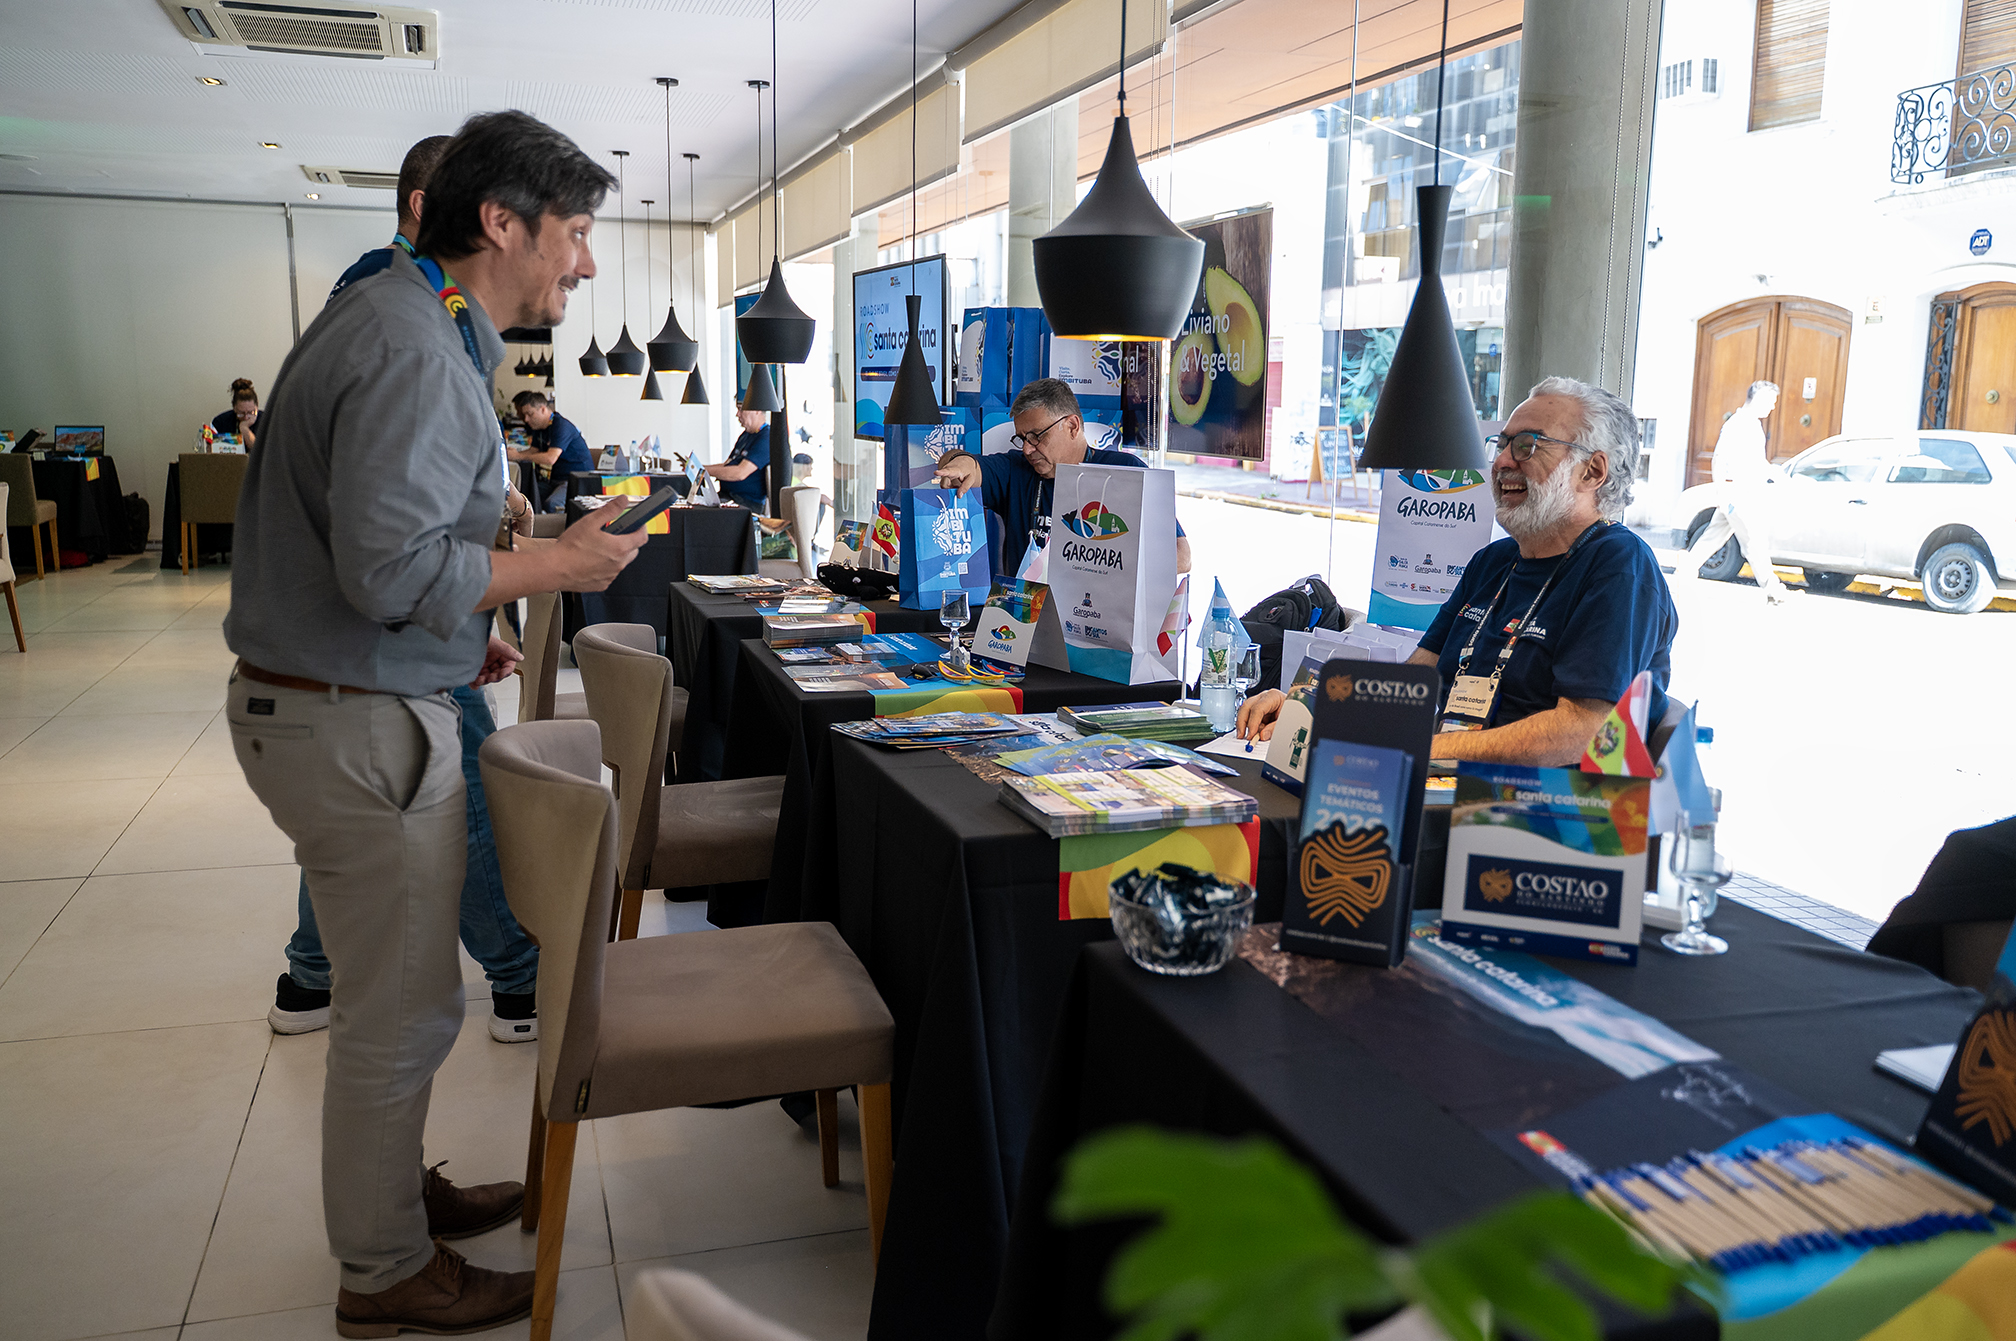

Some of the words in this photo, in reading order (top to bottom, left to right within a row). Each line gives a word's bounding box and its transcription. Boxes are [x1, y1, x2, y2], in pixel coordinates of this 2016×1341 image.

[1973, 236, 1989, 247] ADT
[860, 303, 889, 317] ROADSHOW
[1181, 307, 1230, 336] Liviano
[873, 327, 897, 351] santa
[898, 324, 936, 349] carina
[1180, 344, 1190, 372] &
[1193, 340, 1245, 380] Vegetal
[944, 424, 965, 435] IM
[944, 434, 958, 444] BI
[948, 508, 969, 520] IM
[1396, 496, 1476, 523] GAROPABA
[950, 520, 964, 530] BI
[952, 531, 972, 543] TU
[953, 543, 972, 554] BA
[1062, 540, 1123, 571] GAROPABA
[1414, 565, 1441, 574] Garopaba
[1073, 606, 1101, 619] Garopaba
[988, 640, 1012, 653] GAROPABA
[1493, 776, 1541, 786] ROADSHOW
[1327, 783, 1380, 800] EVENTOS
[1516, 790, 1552, 804] santa
[1554, 795, 1611, 808] catarina
[1475, 961, 1559, 1007] catarina
